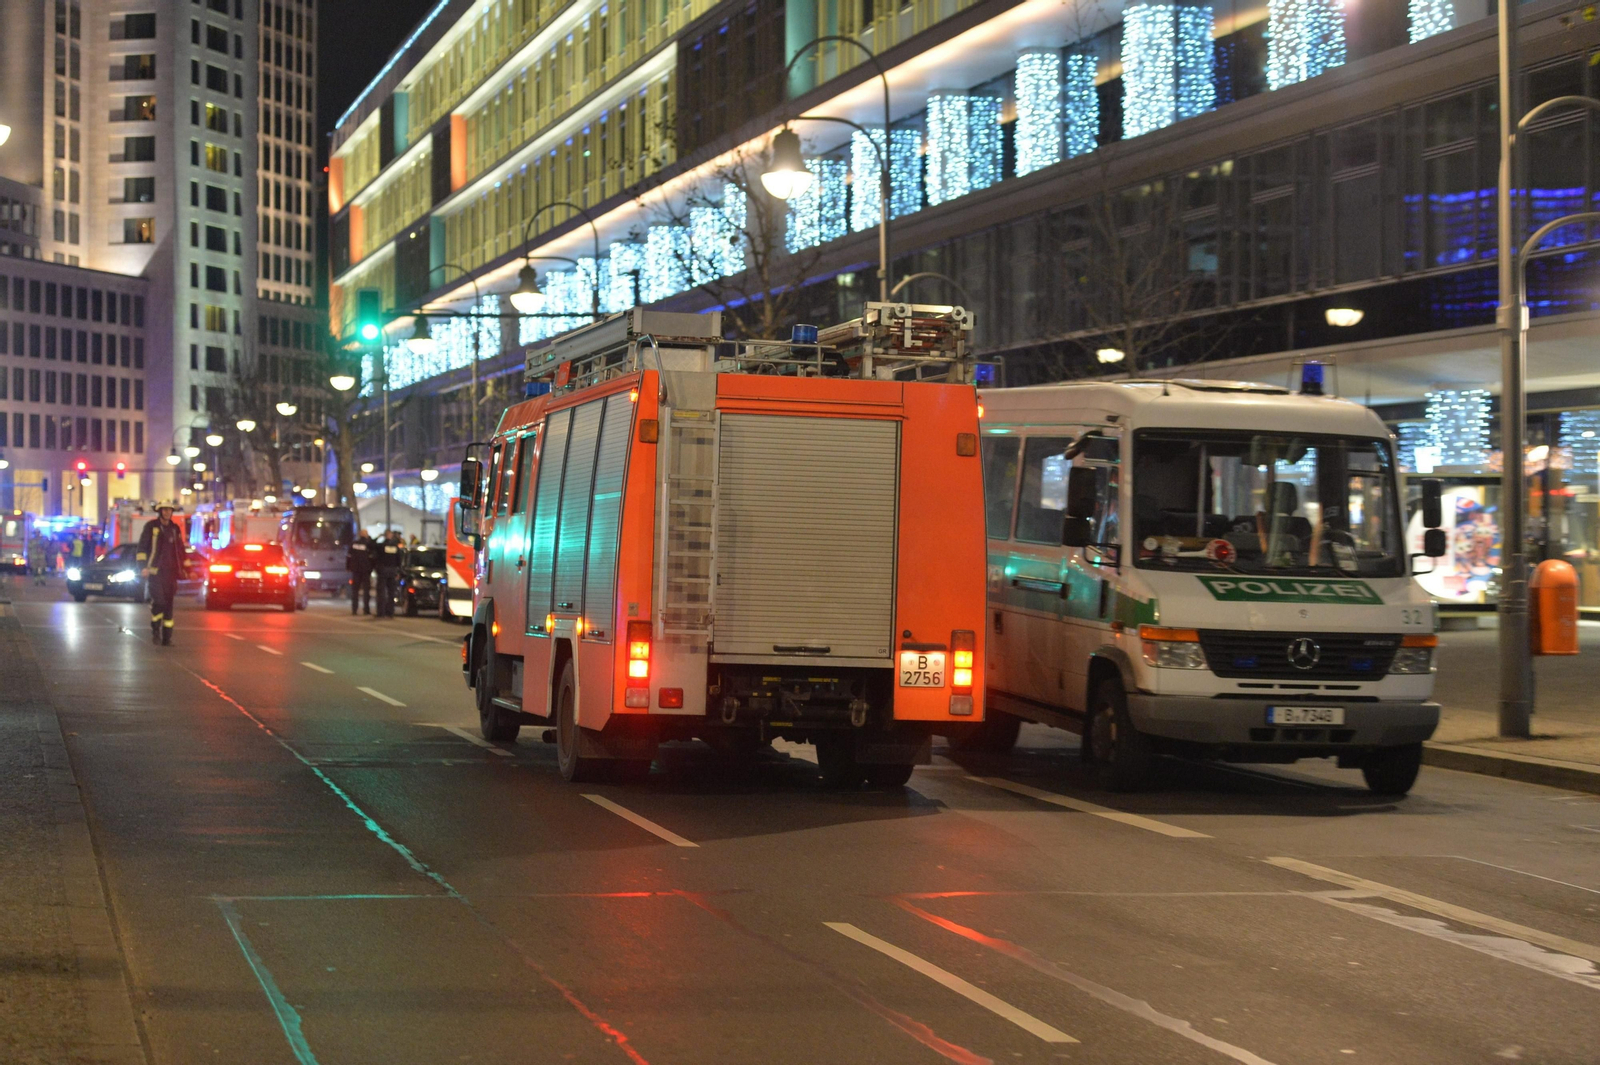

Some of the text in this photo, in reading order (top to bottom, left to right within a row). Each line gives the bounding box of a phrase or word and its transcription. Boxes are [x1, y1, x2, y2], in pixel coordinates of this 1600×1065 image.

[1208, 580, 1375, 599] POLIZEI
[1401, 609, 1424, 625] 32
[918, 655, 928, 670] B
[904, 671, 941, 685] 2756
